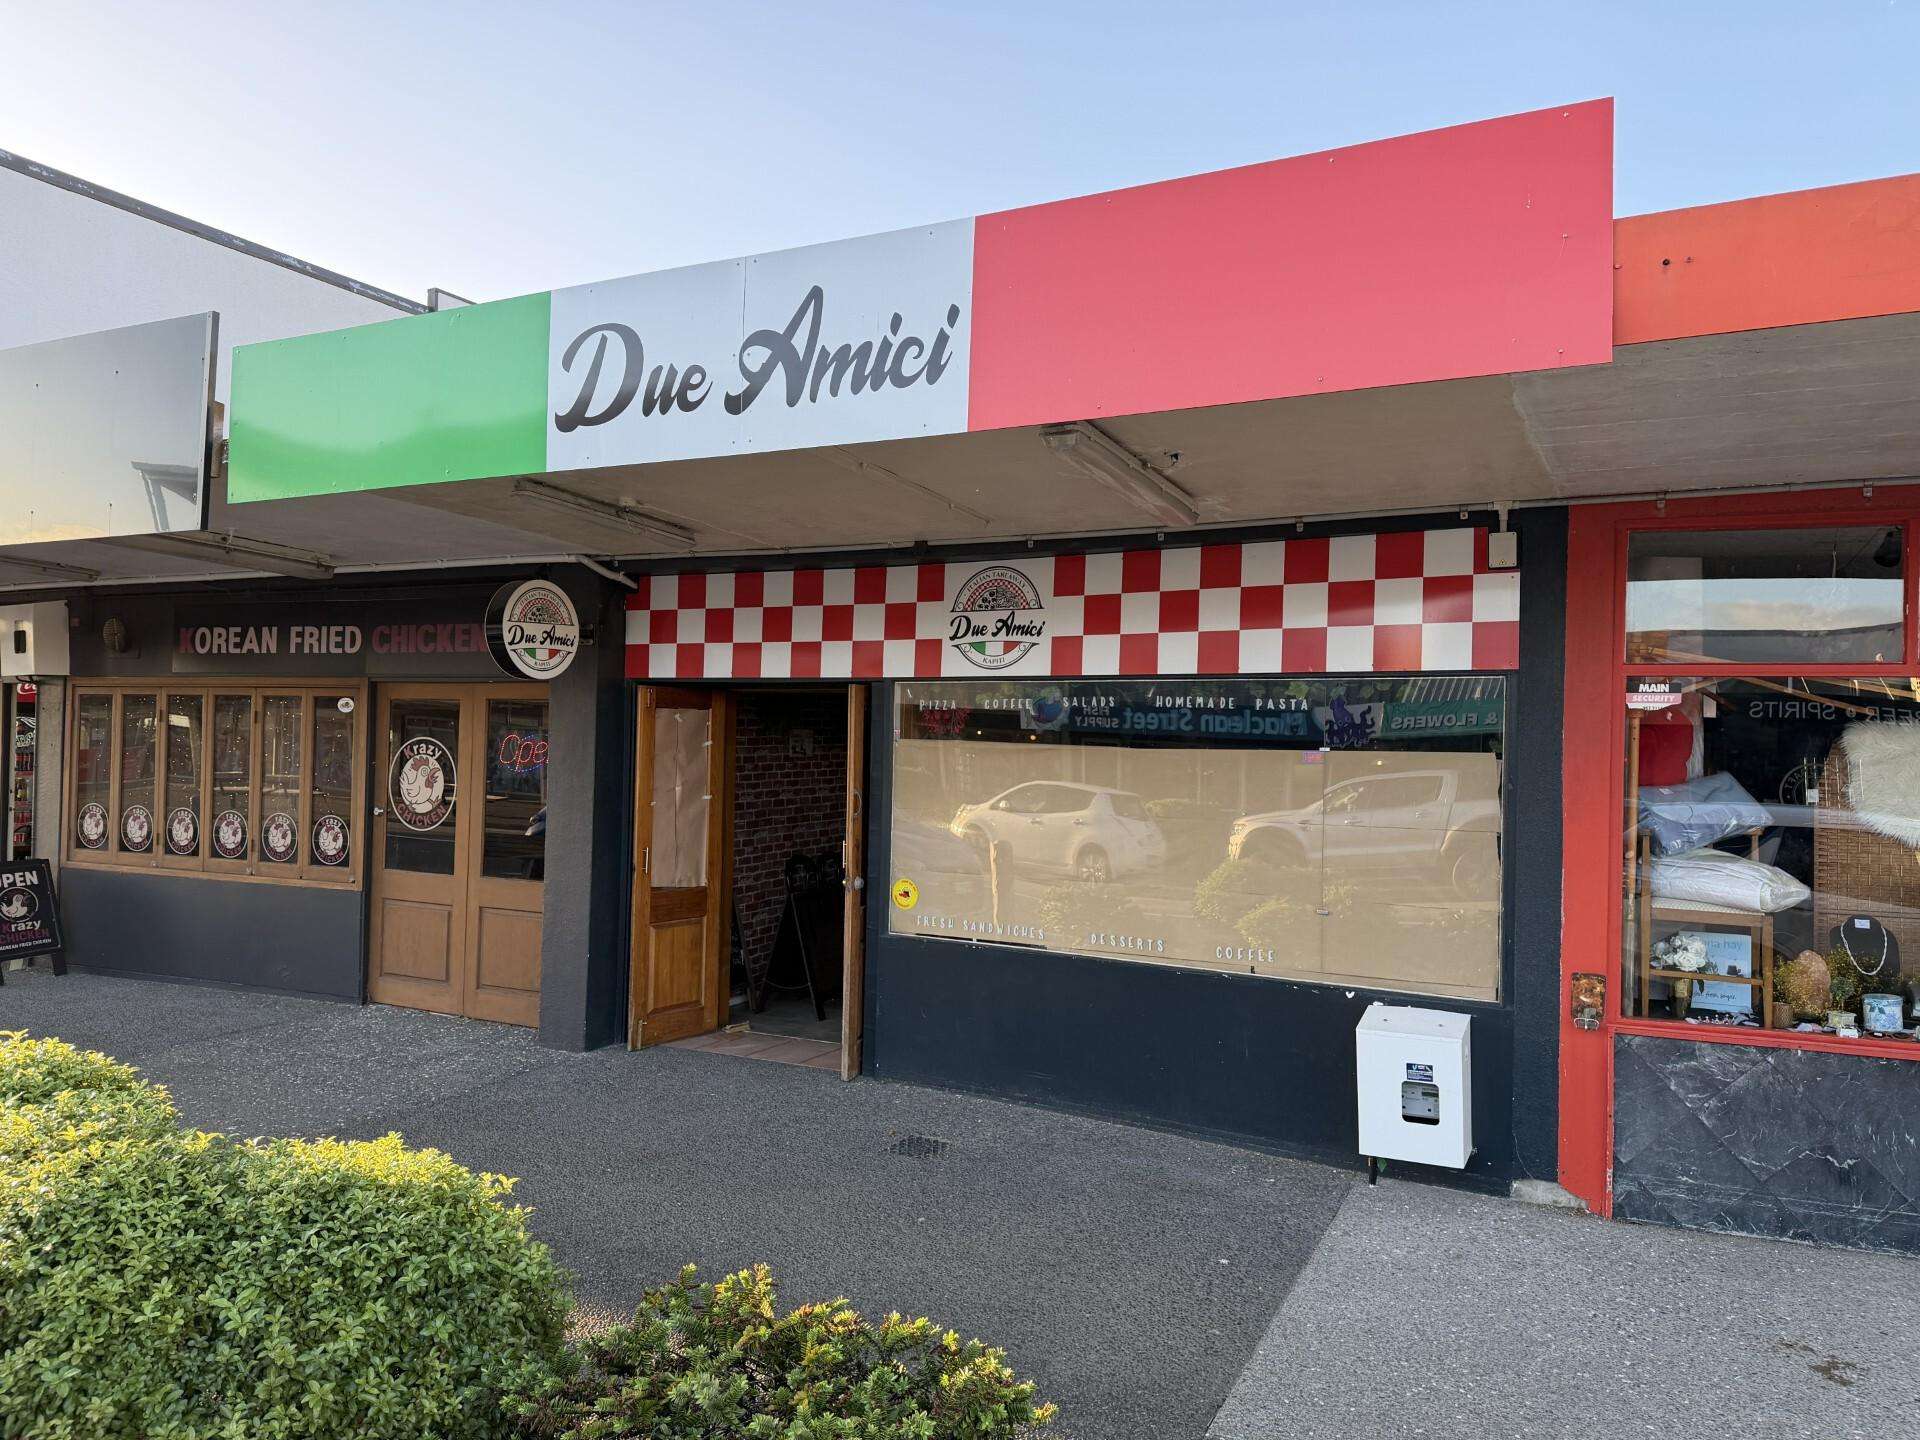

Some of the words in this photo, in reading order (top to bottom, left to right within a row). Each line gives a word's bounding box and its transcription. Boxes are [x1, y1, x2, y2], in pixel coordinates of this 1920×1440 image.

[555, 322, 713, 433] Due
[723, 285, 961, 416] Amici
[967, 574, 991, 592] ITALIAN
[992, 571, 1026, 589] TAKEAWAY
[949, 615, 989, 641] Due
[991, 611, 1046, 638] Amici
[179, 626, 278, 654] KOREAN
[289, 625, 362, 654] FRIED
[371, 623, 487, 653] CHICKEN
[508, 624, 537, 646] Due
[539, 624, 577, 648] Amici
[982, 656, 1006, 665] KAPITI
[1639, 683, 1670, 693] MAIN
[919, 699, 957, 711] PIZZA
[984, 698, 1032, 710] COFFEE
[1063, 696, 1115, 708] SALADS
[1155, 695, 1235, 710] HOMEMADE
[1255, 697, 1309, 711] PASTA
[1632, 694, 1676, 702] SECURITY
[403, 742, 443, 760] Krazy
[500, 734, 549, 772] Ope
[396, 802, 448, 827] CHICKEN
[0, 870, 39, 888] PEN
[916, 915, 955, 929] FRESH
[963, 919, 1045, 941] SANDWICHES
[1090, 933, 1165, 953] DESSERTS
[1216, 945, 1275, 963] COFFEE
